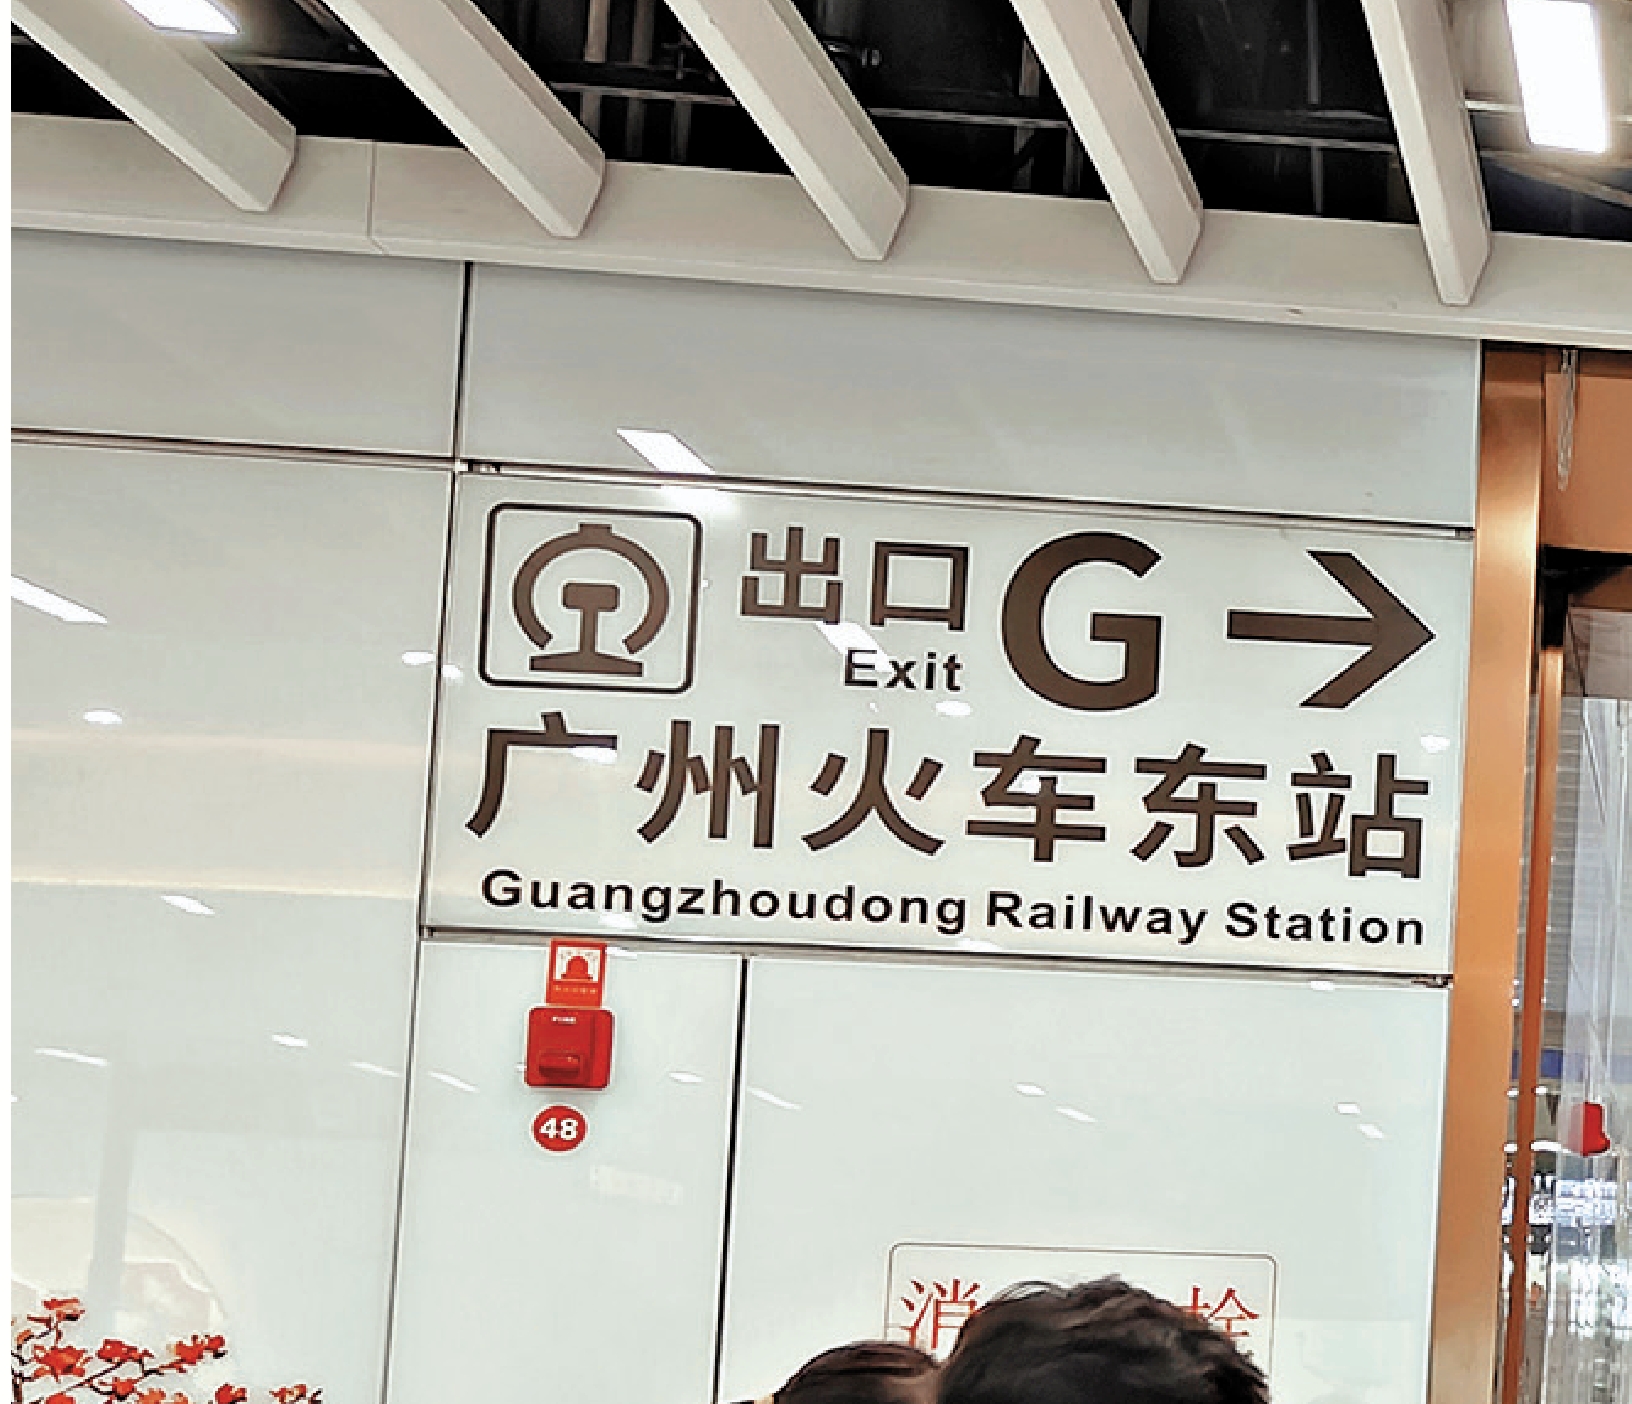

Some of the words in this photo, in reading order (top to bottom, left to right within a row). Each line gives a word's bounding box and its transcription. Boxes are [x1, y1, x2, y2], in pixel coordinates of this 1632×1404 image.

[740, 527, 969, 631] 出口
[1001, 531, 1162, 712] G
[843, 649, 962, 693] Exit
[466, 712, 1429, 878] 广州火车东站
[481, 868, 967, 935] Guangzhoudong
[986, 891, 1207, 946] Railway
[1225, 902, 1424, 945] Station
[539, 1117, 578, 1140] 48
